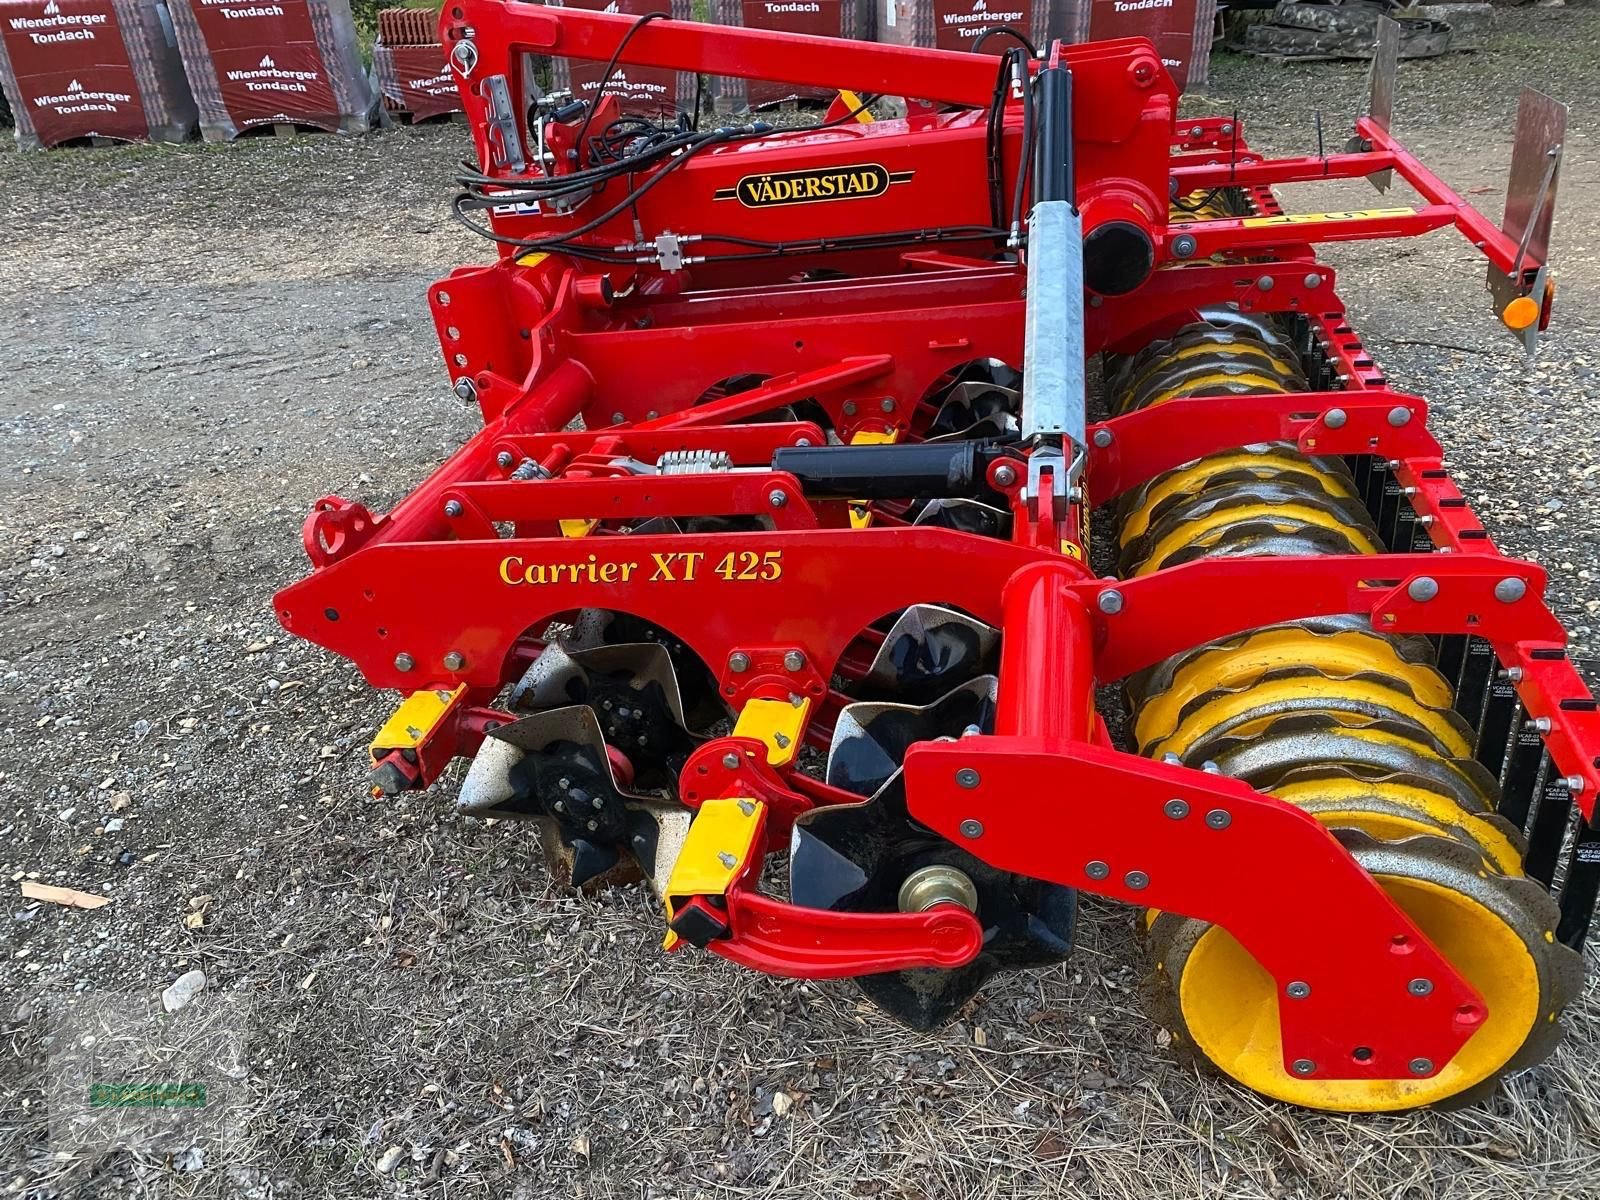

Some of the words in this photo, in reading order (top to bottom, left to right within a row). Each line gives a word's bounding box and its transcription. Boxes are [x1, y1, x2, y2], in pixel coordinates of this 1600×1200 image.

[220, 5, 284, 19] Tondach
[765, 2, 820, 13] Tondach
[9, 13, 107, 30] Wienerberger
[944, 11, 1024, 24] Wienerberger
[30, 29, 95, 44] Tondach
[226, 68, 318, 81] Wienerberger
[246, 82, 307, 92] Tondach
[34, 91, 131, 107] Wienerberger
[54, 103, 117, 115] Tondach
[747, 171, 878, 202] VÄDERSTAD
[499, 554, 638, 585] Carrier
[649, 552, 704, 581] XT
[714, 550, 782, 581] 425
